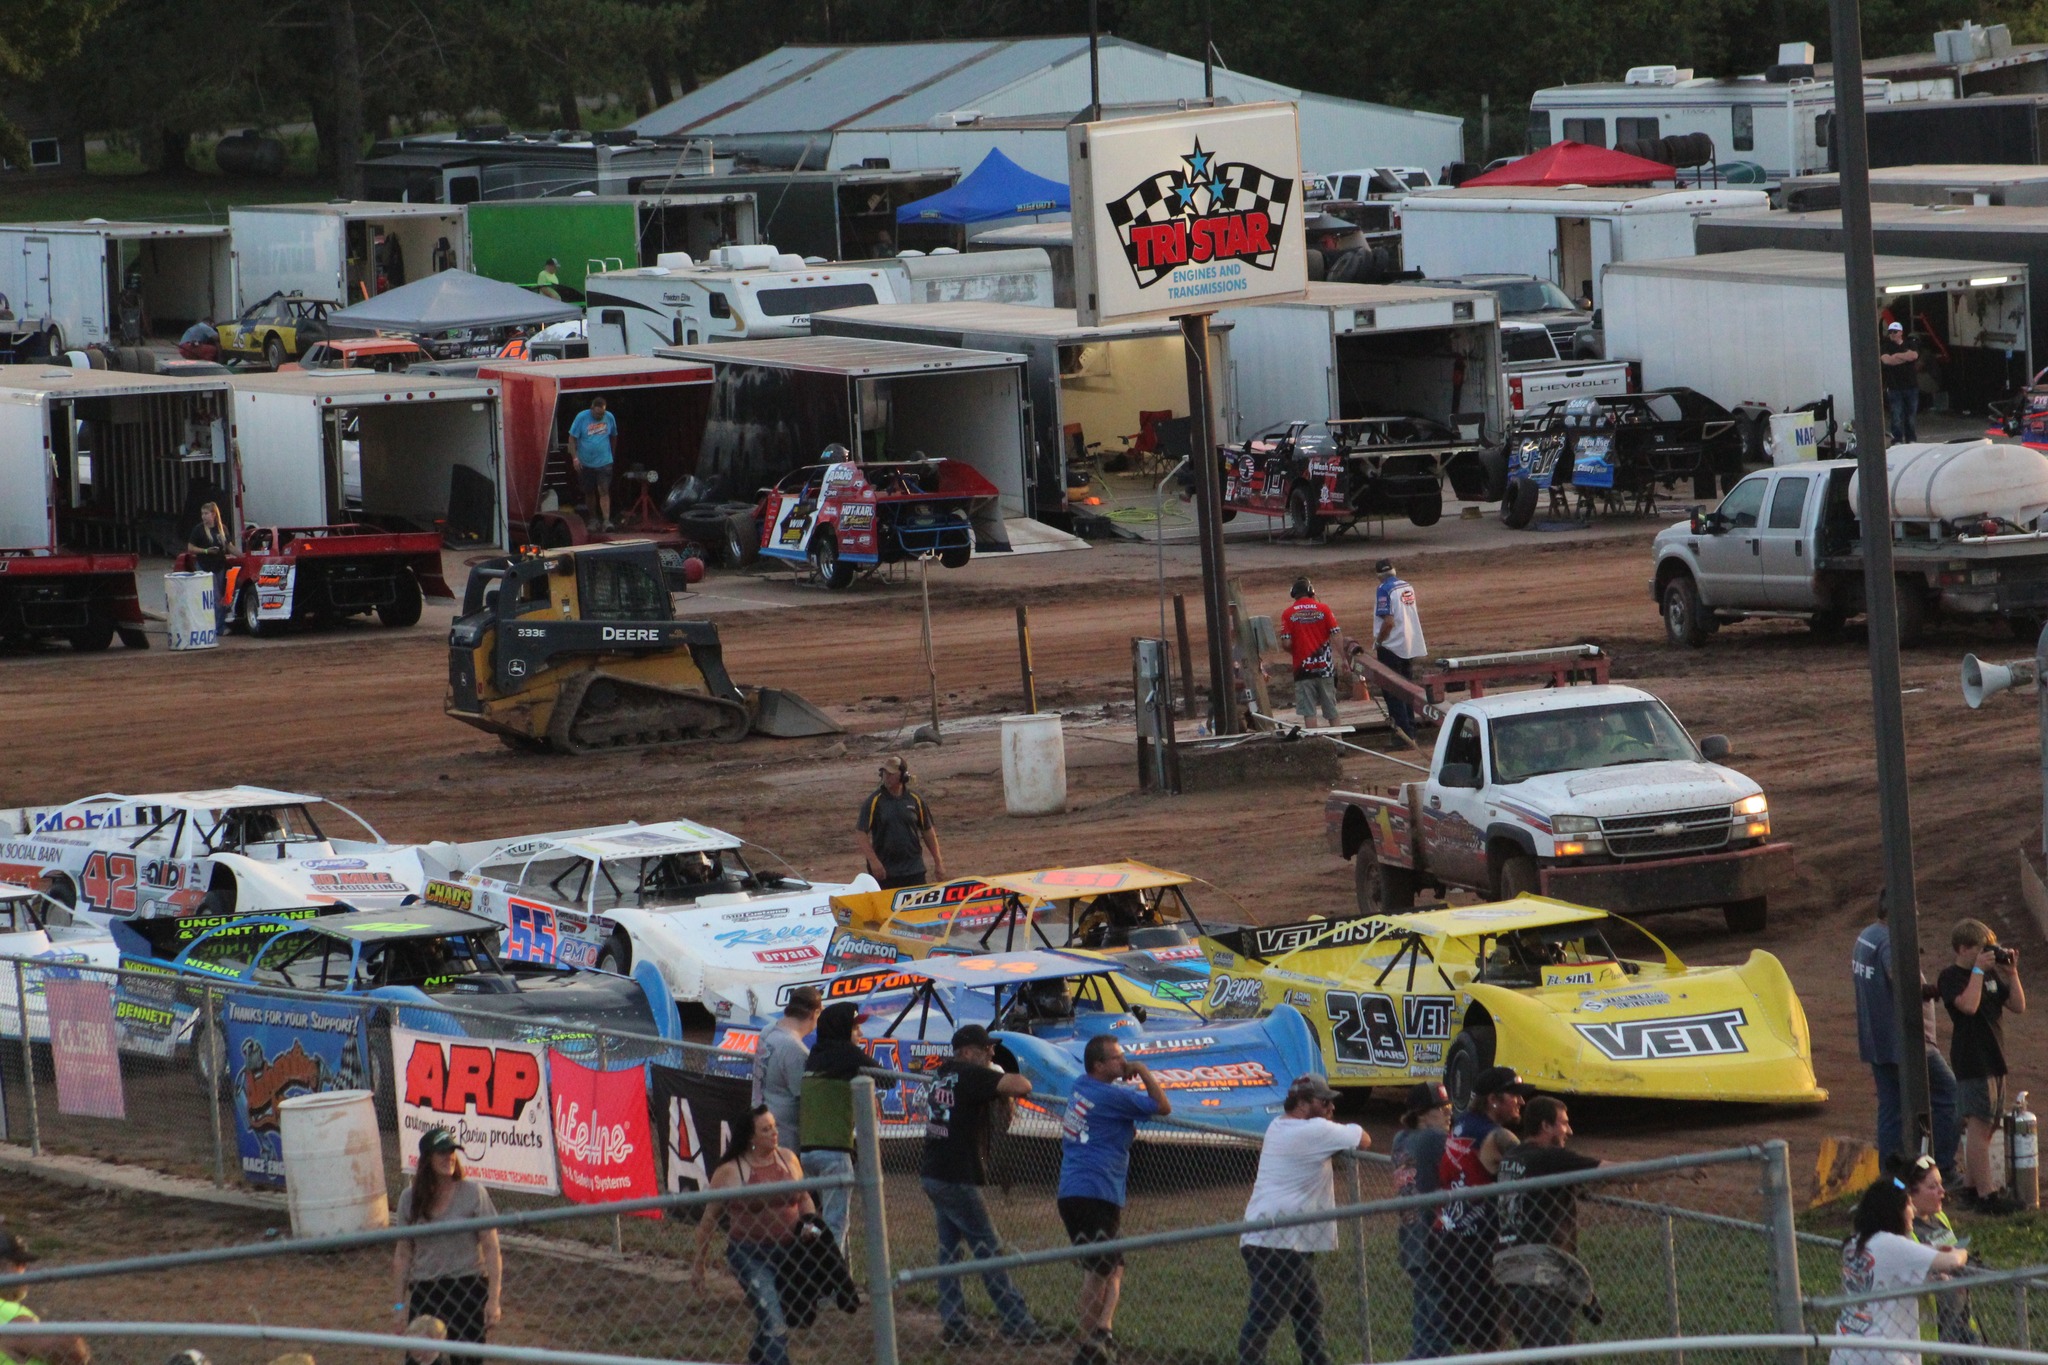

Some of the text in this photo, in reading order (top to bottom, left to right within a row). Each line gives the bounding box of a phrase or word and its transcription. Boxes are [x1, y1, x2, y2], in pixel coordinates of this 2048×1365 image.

[1130, 211, 1274, 268] TRI STAR
[1172, 263, 1242, 284] ENGINES AND
[1167, 278, 1248, 300] TRANSMISSIONS
[1530, 378, 1619, 393] CHEVROLET
[602, 626, 659, 642] DEERE
[35, 807, 122, 834] Mobil
[6, 842, 37, 862] SOCIAL
[37, 846, 64, 864] BARN
[81, 850, 138, 916] 42
[315, 883, 405, 892] REMODELING
[338, 872, 391, 884] MILE
[426, 881, 472, 911] CHAD'S
[901, 891, 941, 906] MB
[179, 930, 194, 940] &
[714, 924, 829, 949] Kelly
[832, 931, 897, 959] Anderson
[1256, 922, 1328, 953] VEIT
[562, 939, 587, 962] PMI
[762, 947, 814, 963] bryant
[1153, 946, 1205, 961] KLU
[184, 957, 242, 978] NIZNIK
[1209, 973, 1263, 1008] Deppe
[115, 1001, 174, 1026] BENNETT
[1402, 994, 1456, 1040] VEIT
[1325, 989, 1409, 1067] 28
[1570, 1007, 1749, 1062] VEIT
[1155, 1036, 1216, 1049] LUCIA
[1375, 1049, 1405, 1061] MARS
[404, 1039, 540, 1121] ARP
[458, 1117, 488, 1162] Racing
[489, 1125, 543, 1149] products
[462, 1165, 482, 1179] ACING
[481, 1166, 509, 1182] FASTENER
[508, 1171, 548, 1186] TECHNOLOGY
[573, 1170, 594, 1192] Safety
[594, 1174, 631, 1193] Systems
